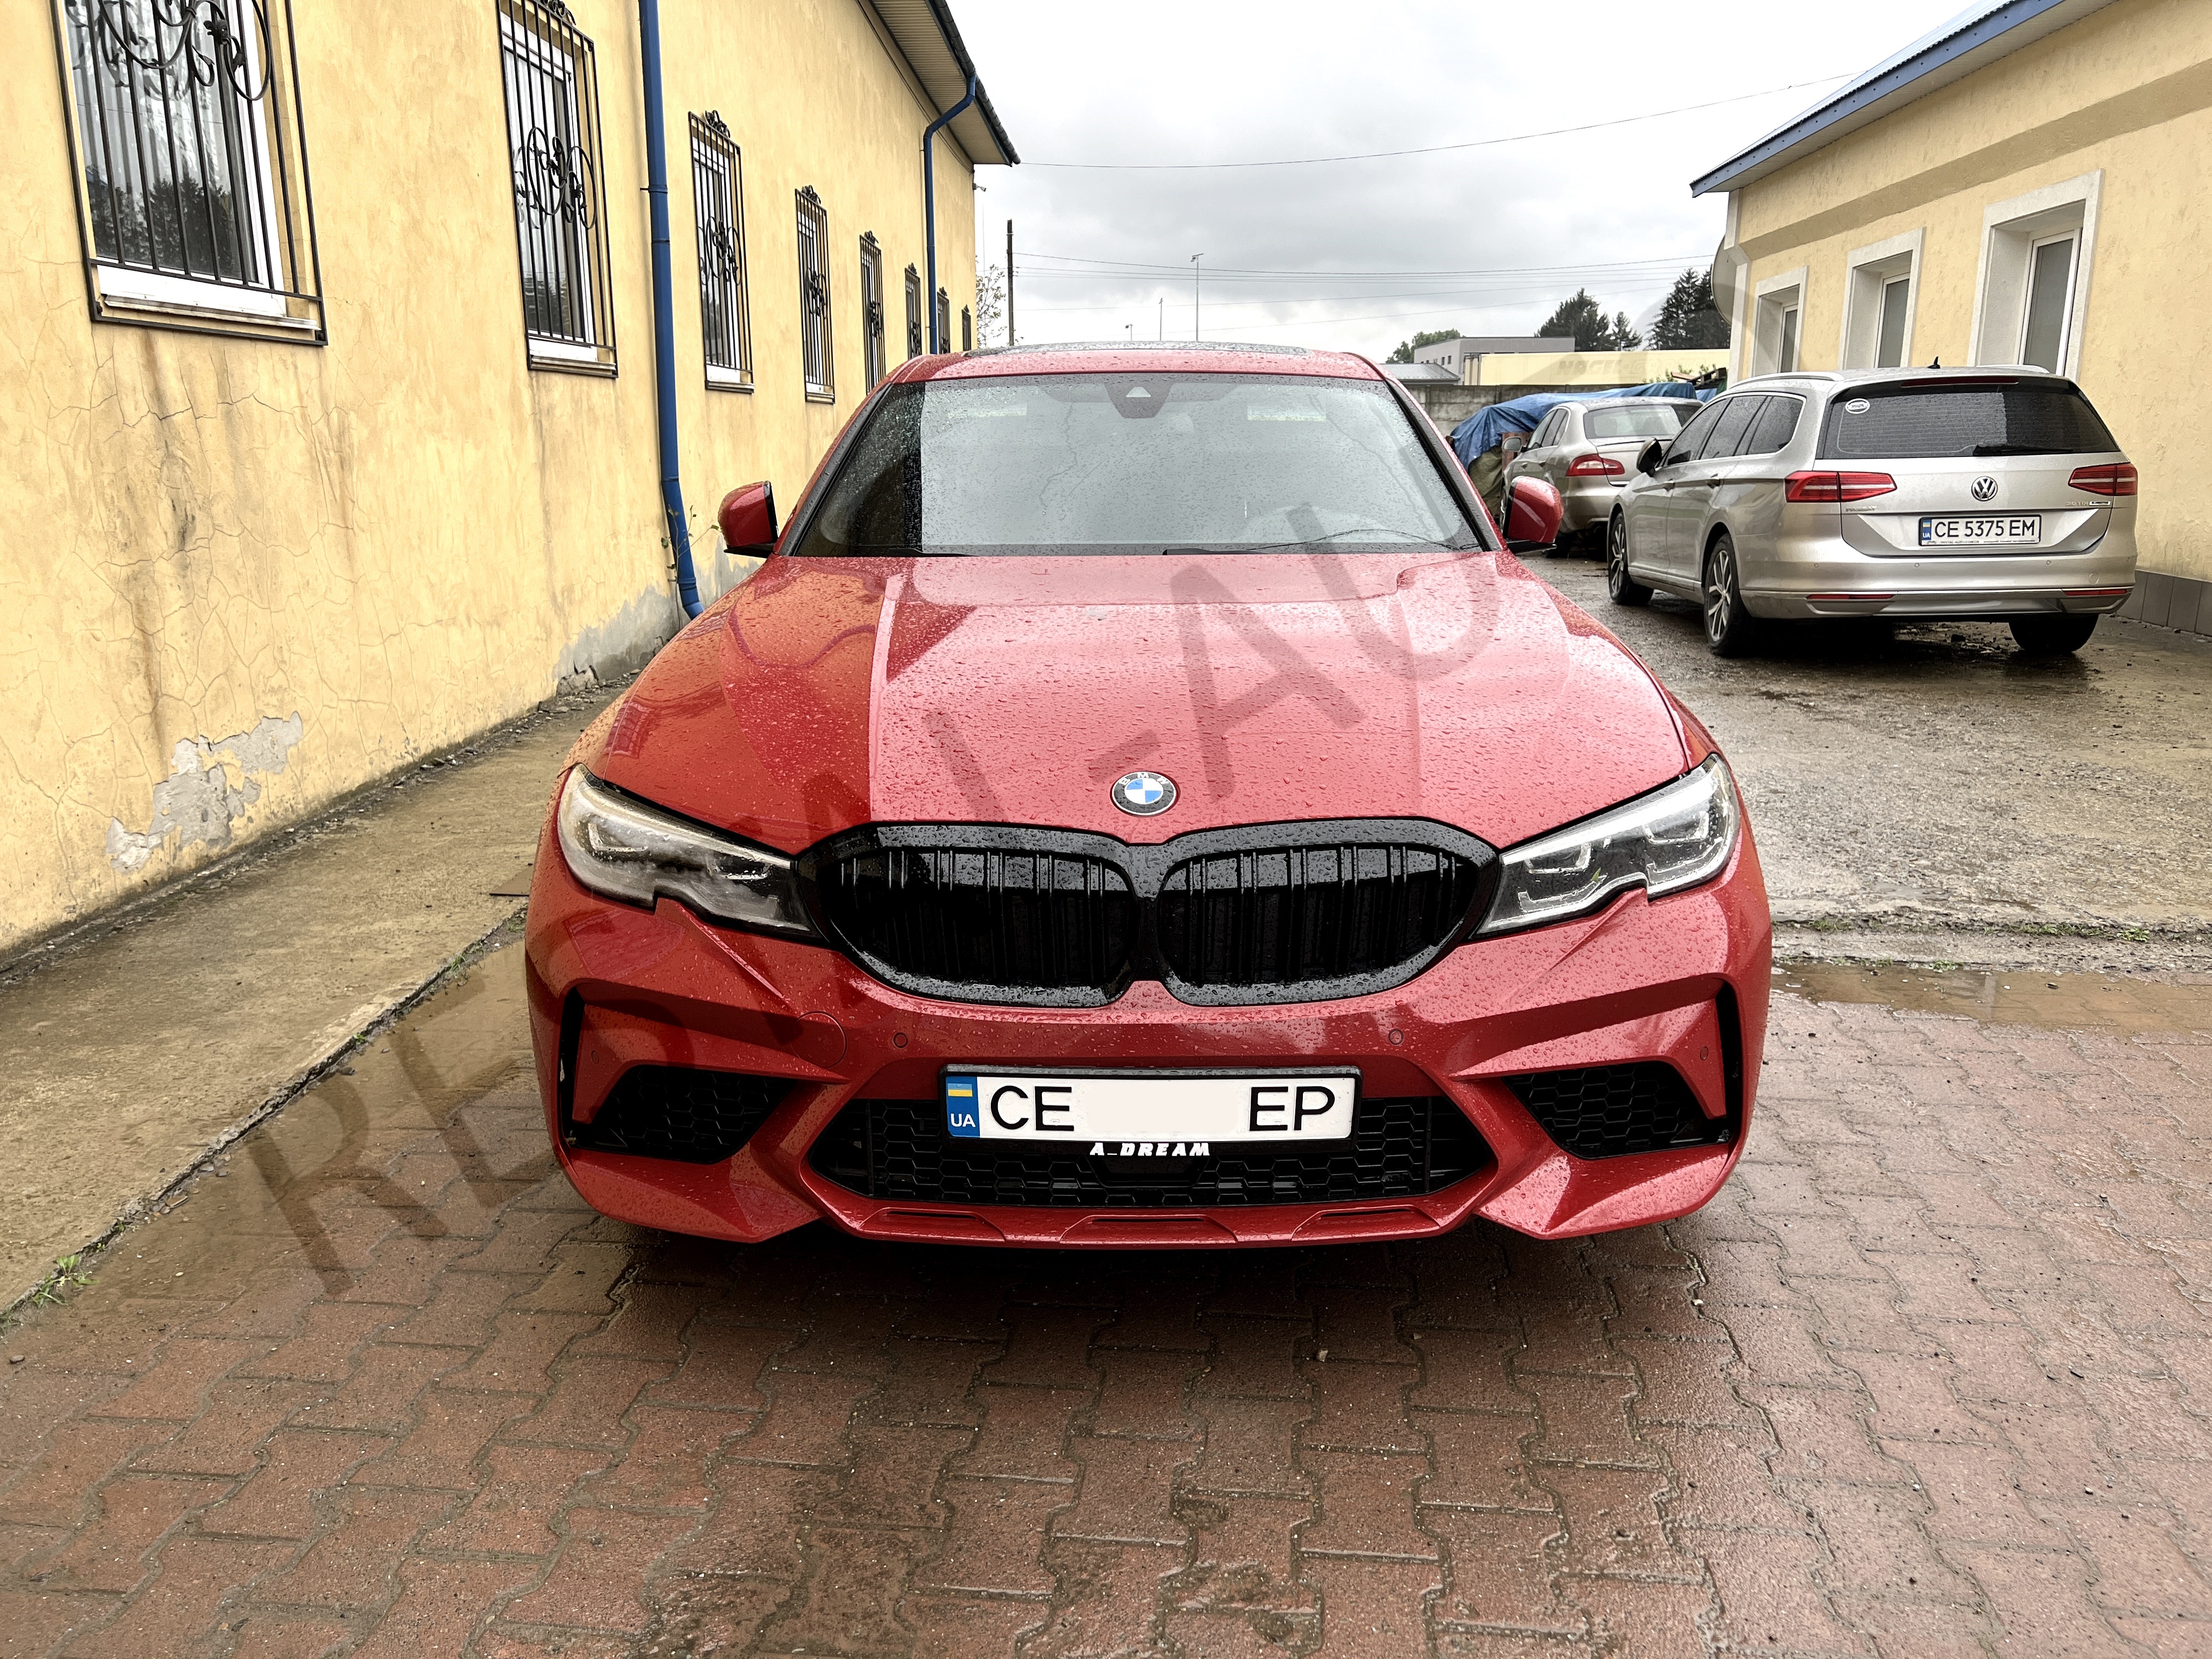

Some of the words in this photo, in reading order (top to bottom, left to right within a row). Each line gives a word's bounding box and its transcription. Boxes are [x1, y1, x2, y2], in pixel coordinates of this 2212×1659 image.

[1934, 521, 1959, 537] CE
[1964, 520, 2004, 537] 5375
[2009, 520, 2035, 536] EM
[1119, 772, 1169, 786] BMW
[990, 1085, 1074, 1131] CE
[1250, 1086, 1335, 1131] EP
[950, 1113, 975, 1127] UA
